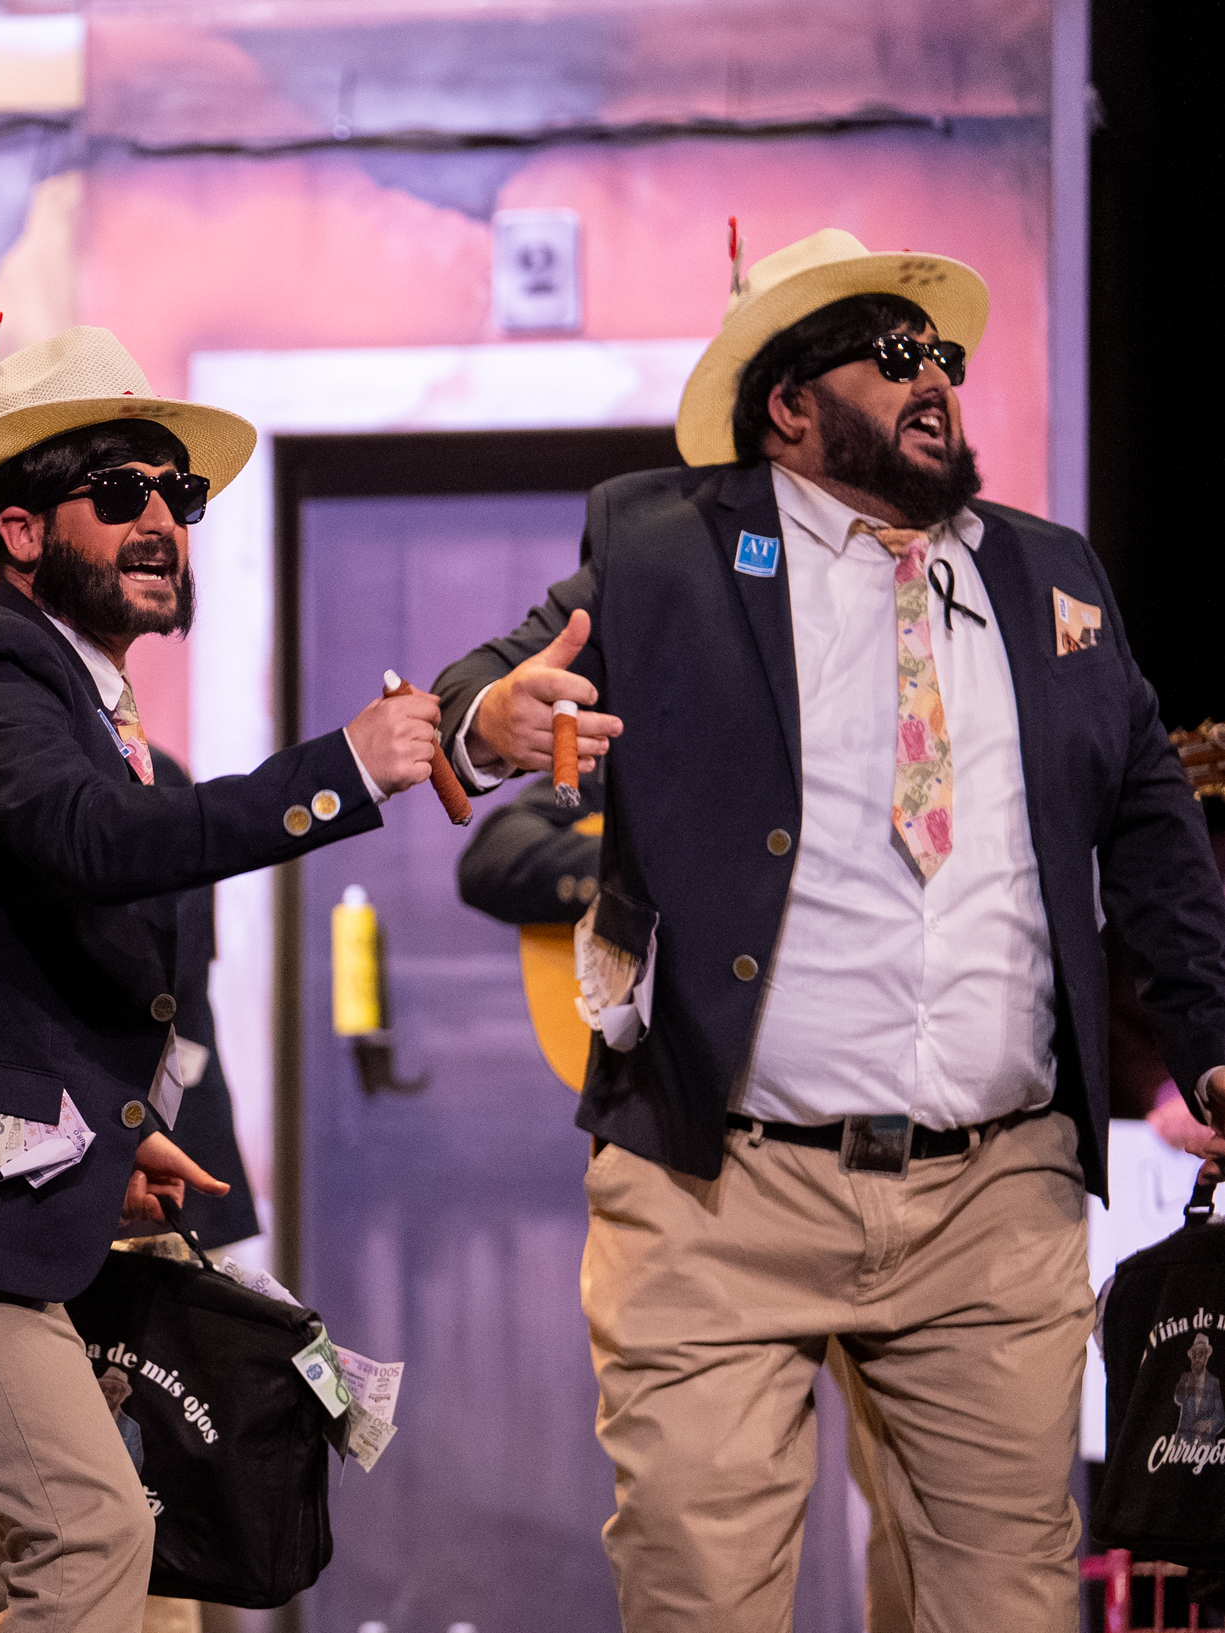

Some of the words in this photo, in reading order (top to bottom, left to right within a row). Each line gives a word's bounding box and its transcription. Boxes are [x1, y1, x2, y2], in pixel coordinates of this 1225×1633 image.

[745, 538, 774, 557] AT
[1149, 1316, 1190, 1349] Viña
[1192, 1307, 1213, 1330] de
[107, 1341, 138, 1369] de
[139, 1359, 185, 1397] mis
[183, 1395, 219, 1444] ojos
